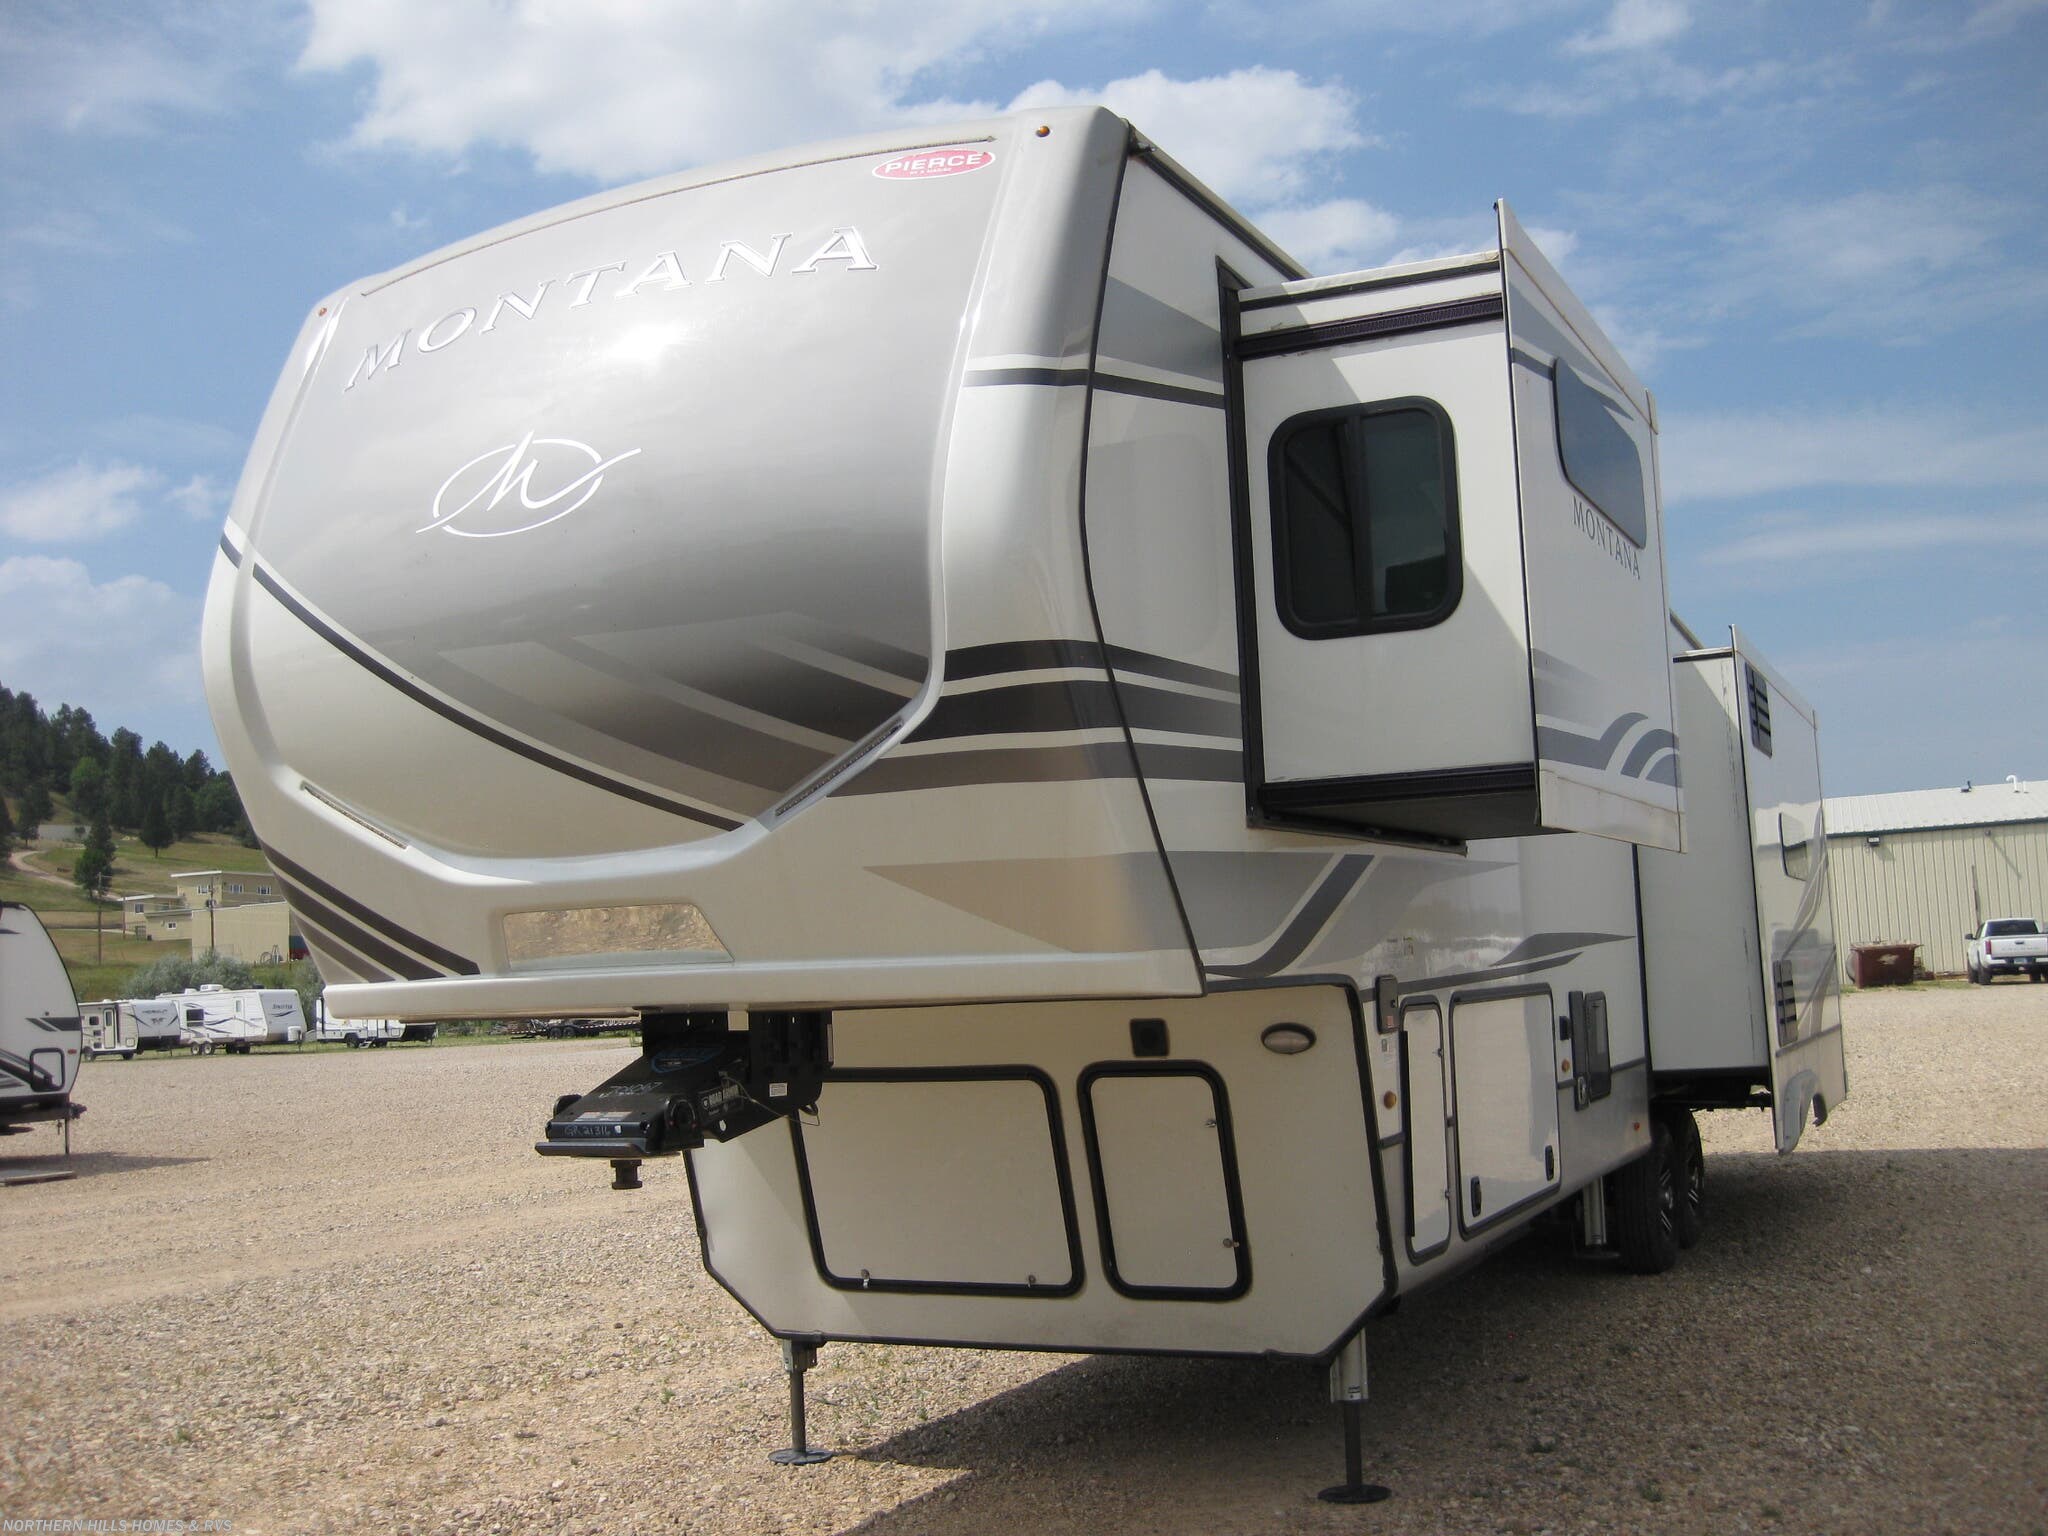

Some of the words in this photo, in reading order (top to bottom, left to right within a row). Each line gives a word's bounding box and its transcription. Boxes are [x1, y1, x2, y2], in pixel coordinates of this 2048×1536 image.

[884, 153, 984, 174] PIERCE
[343, 225, 880, 392] MONTANA
[1572, 495, 1641, 581] MONTANA
